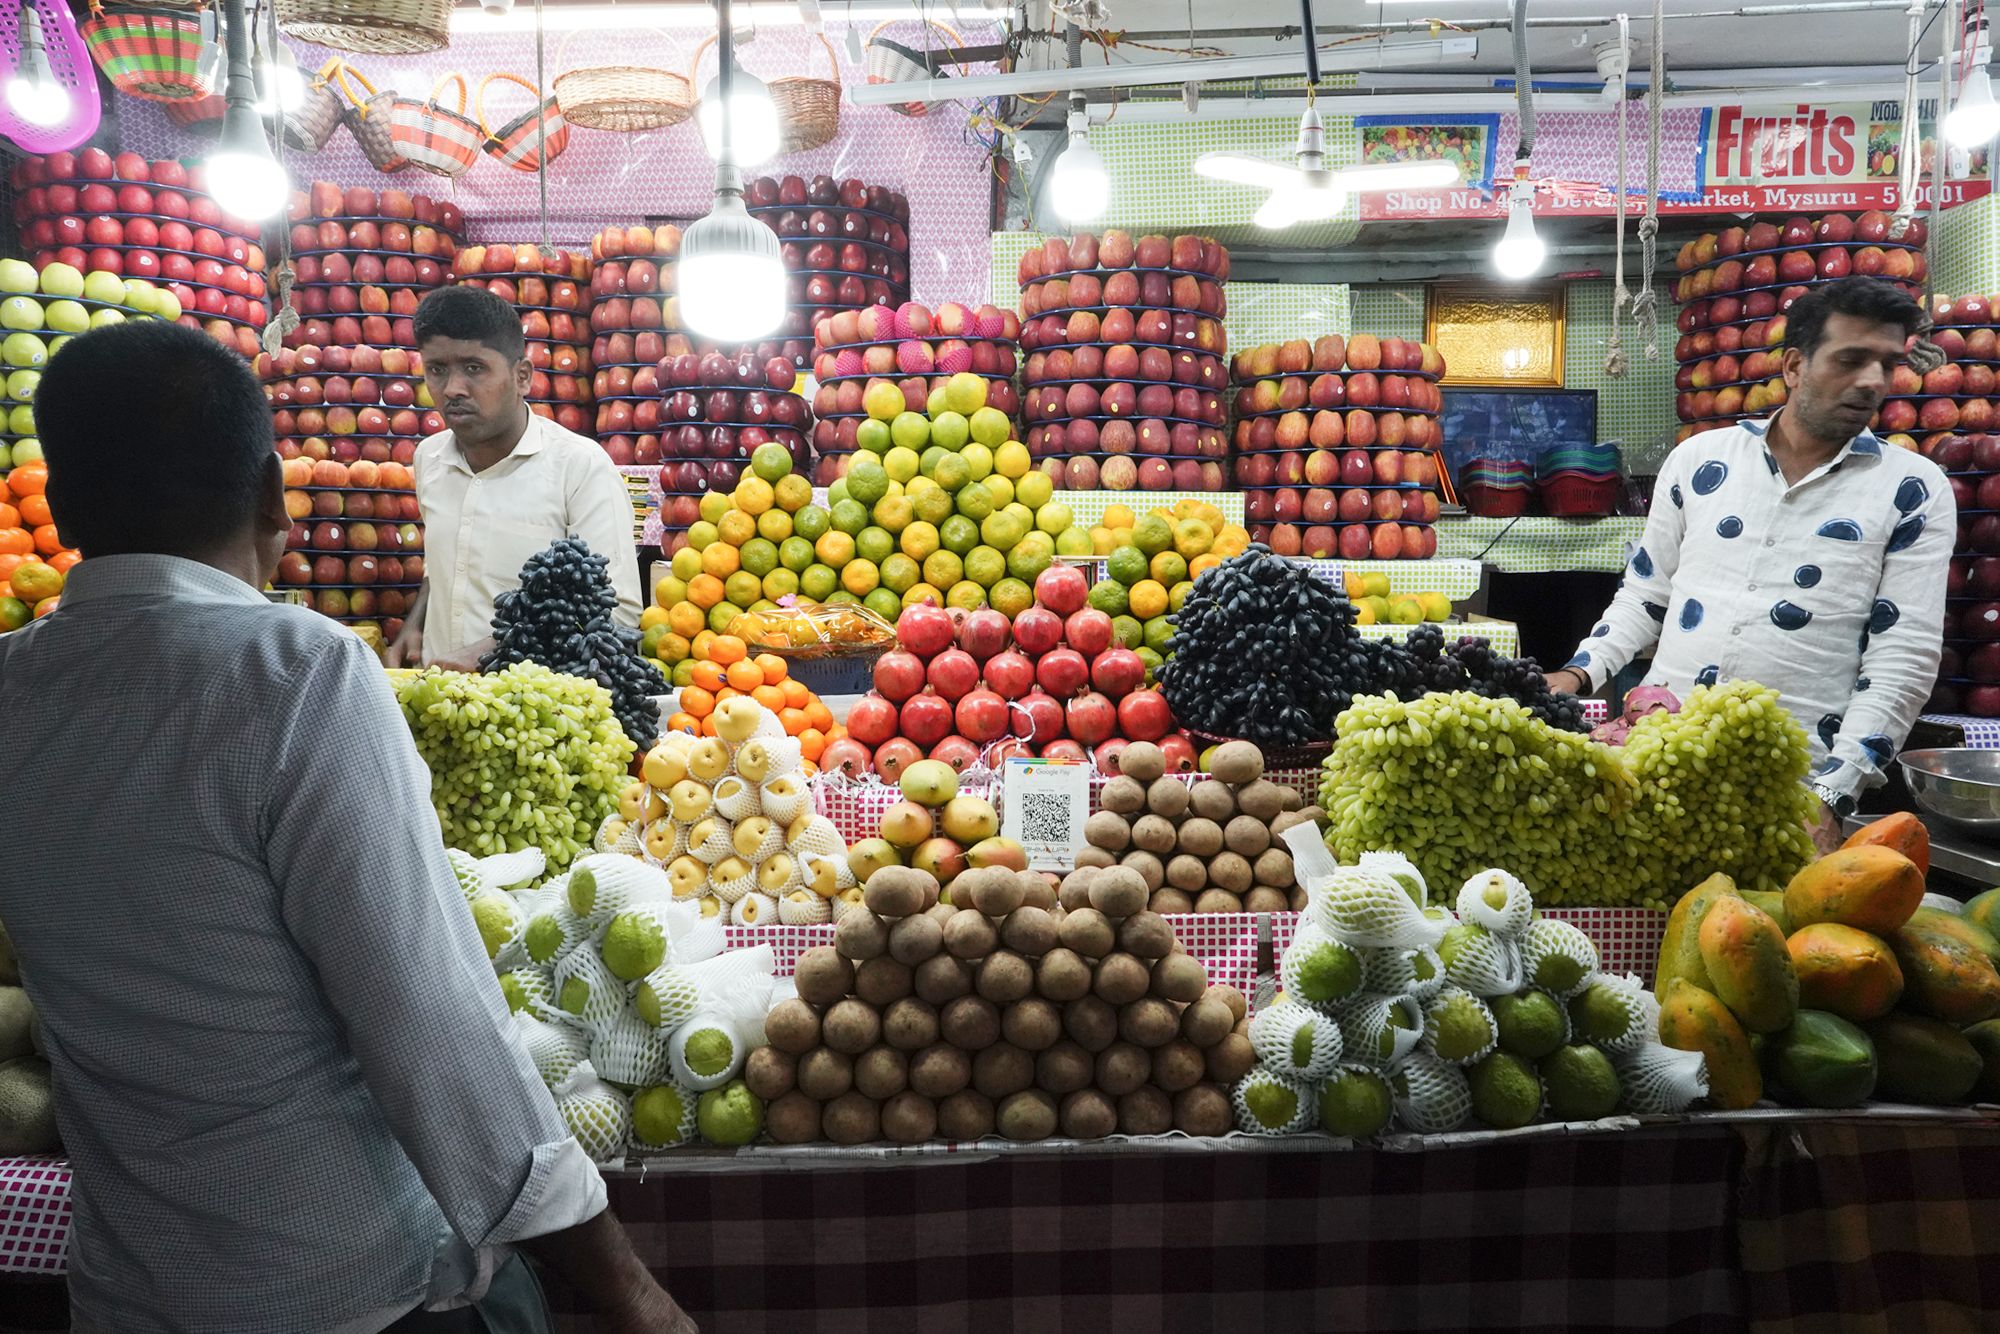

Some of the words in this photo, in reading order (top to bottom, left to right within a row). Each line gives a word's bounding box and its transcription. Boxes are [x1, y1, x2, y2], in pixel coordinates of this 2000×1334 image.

[1715, 104, 1856, 178] Fruits
[1385, 191, 1442, 213] Shop
[1449, 191, 1488, 209] No.
[1763, 188, 1857, 209] Mysuru
[1882, 185, 1965, 204] 50001
[1035, 767, 1059, 776] Google
